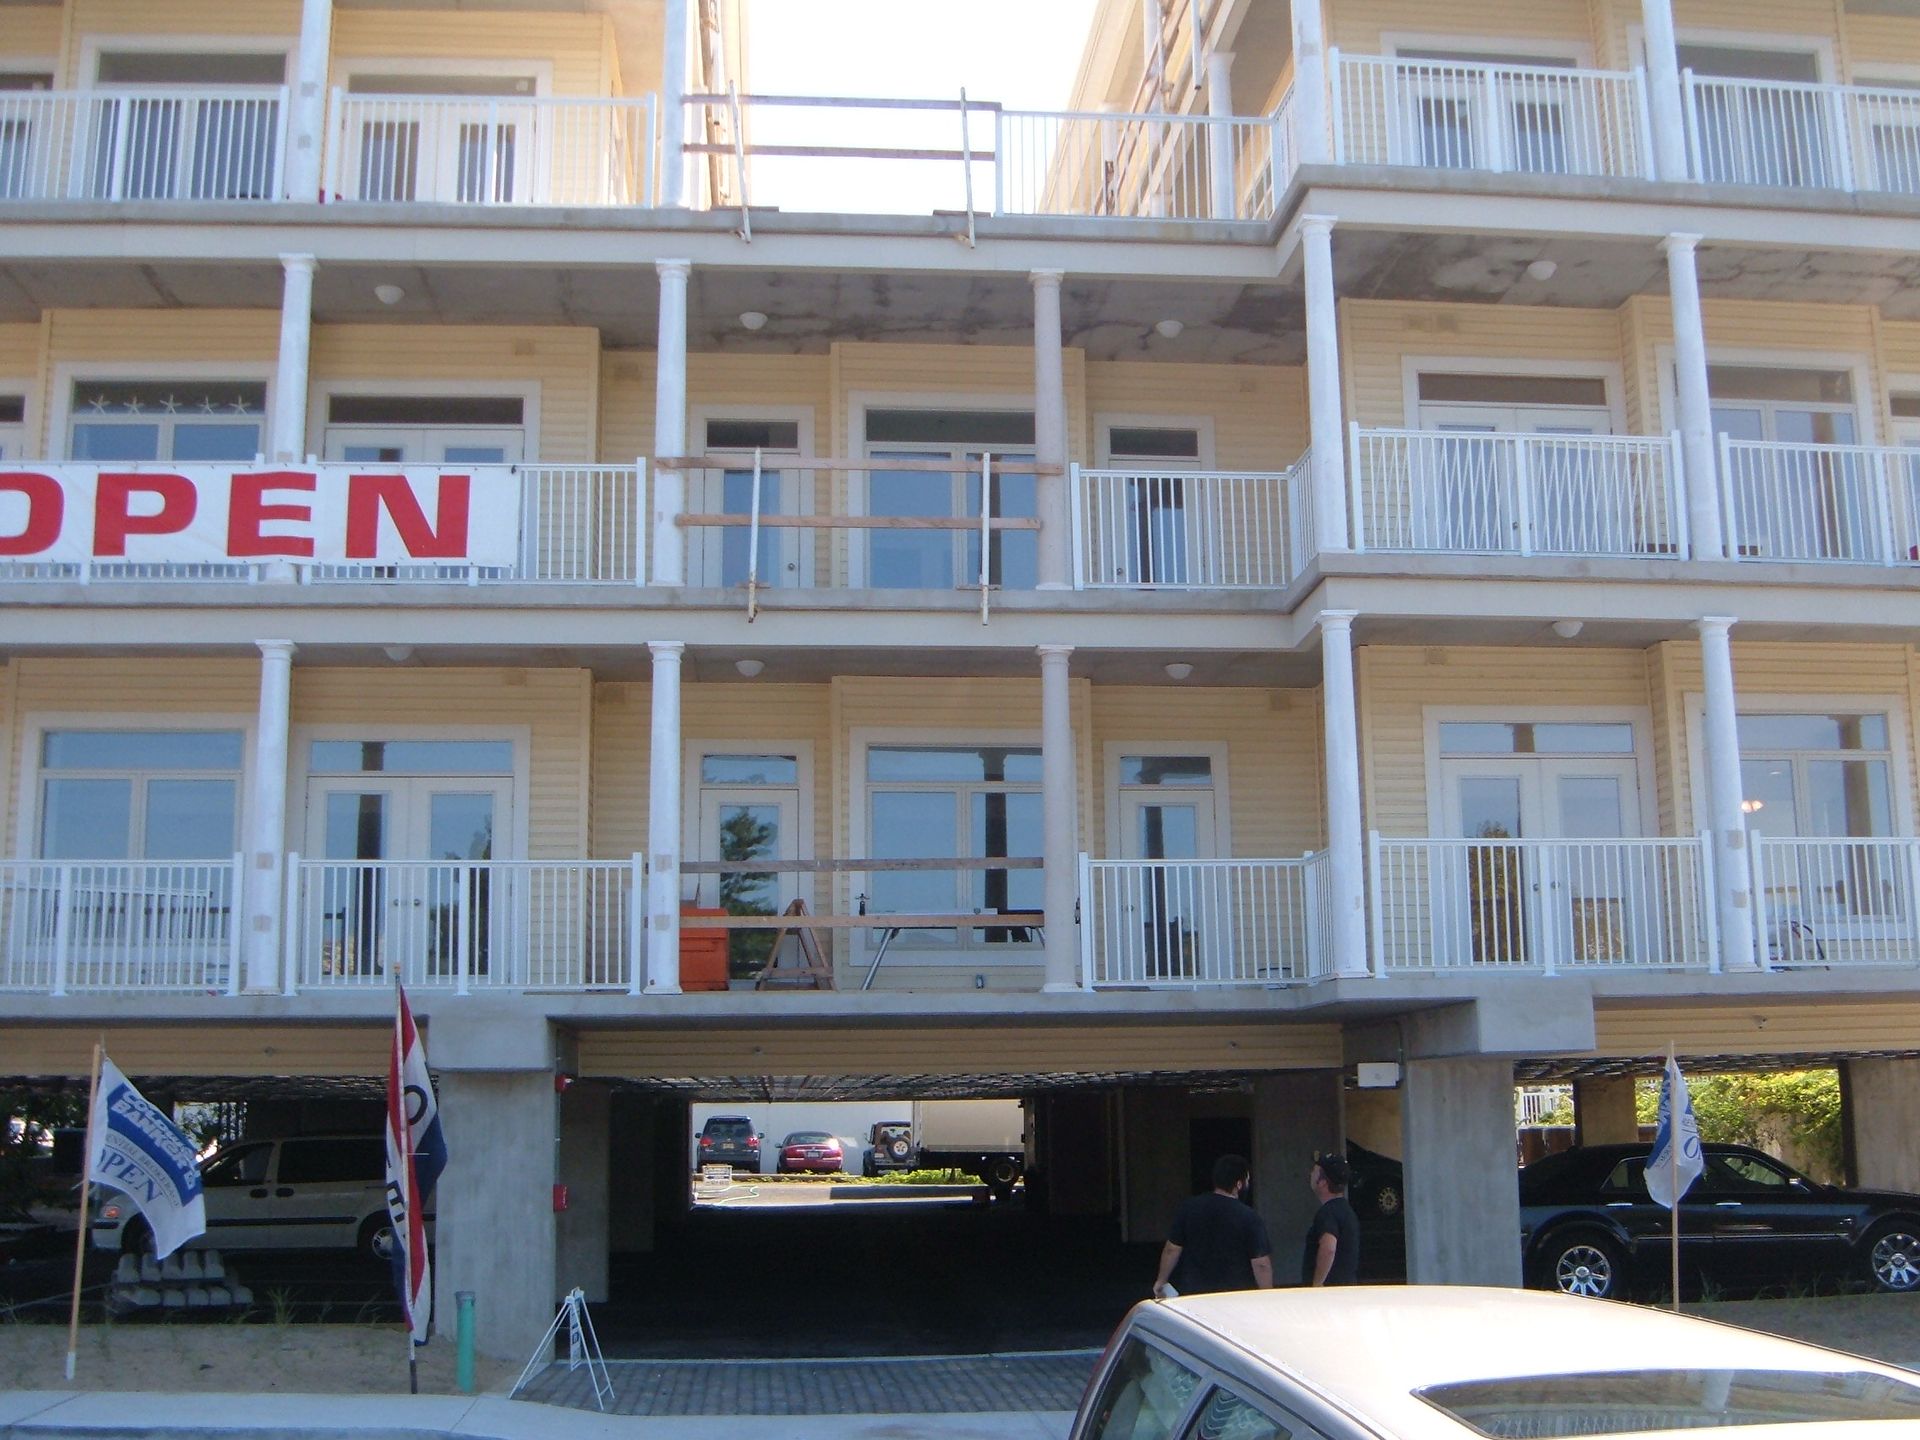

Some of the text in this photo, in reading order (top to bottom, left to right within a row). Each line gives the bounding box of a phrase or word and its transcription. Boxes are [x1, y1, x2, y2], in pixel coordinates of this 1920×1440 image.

[0, 471, 470, 559] OPEN
[111, 1099, 191, 1170] BANKER
[101, 1149, 163, 1203] PEN
